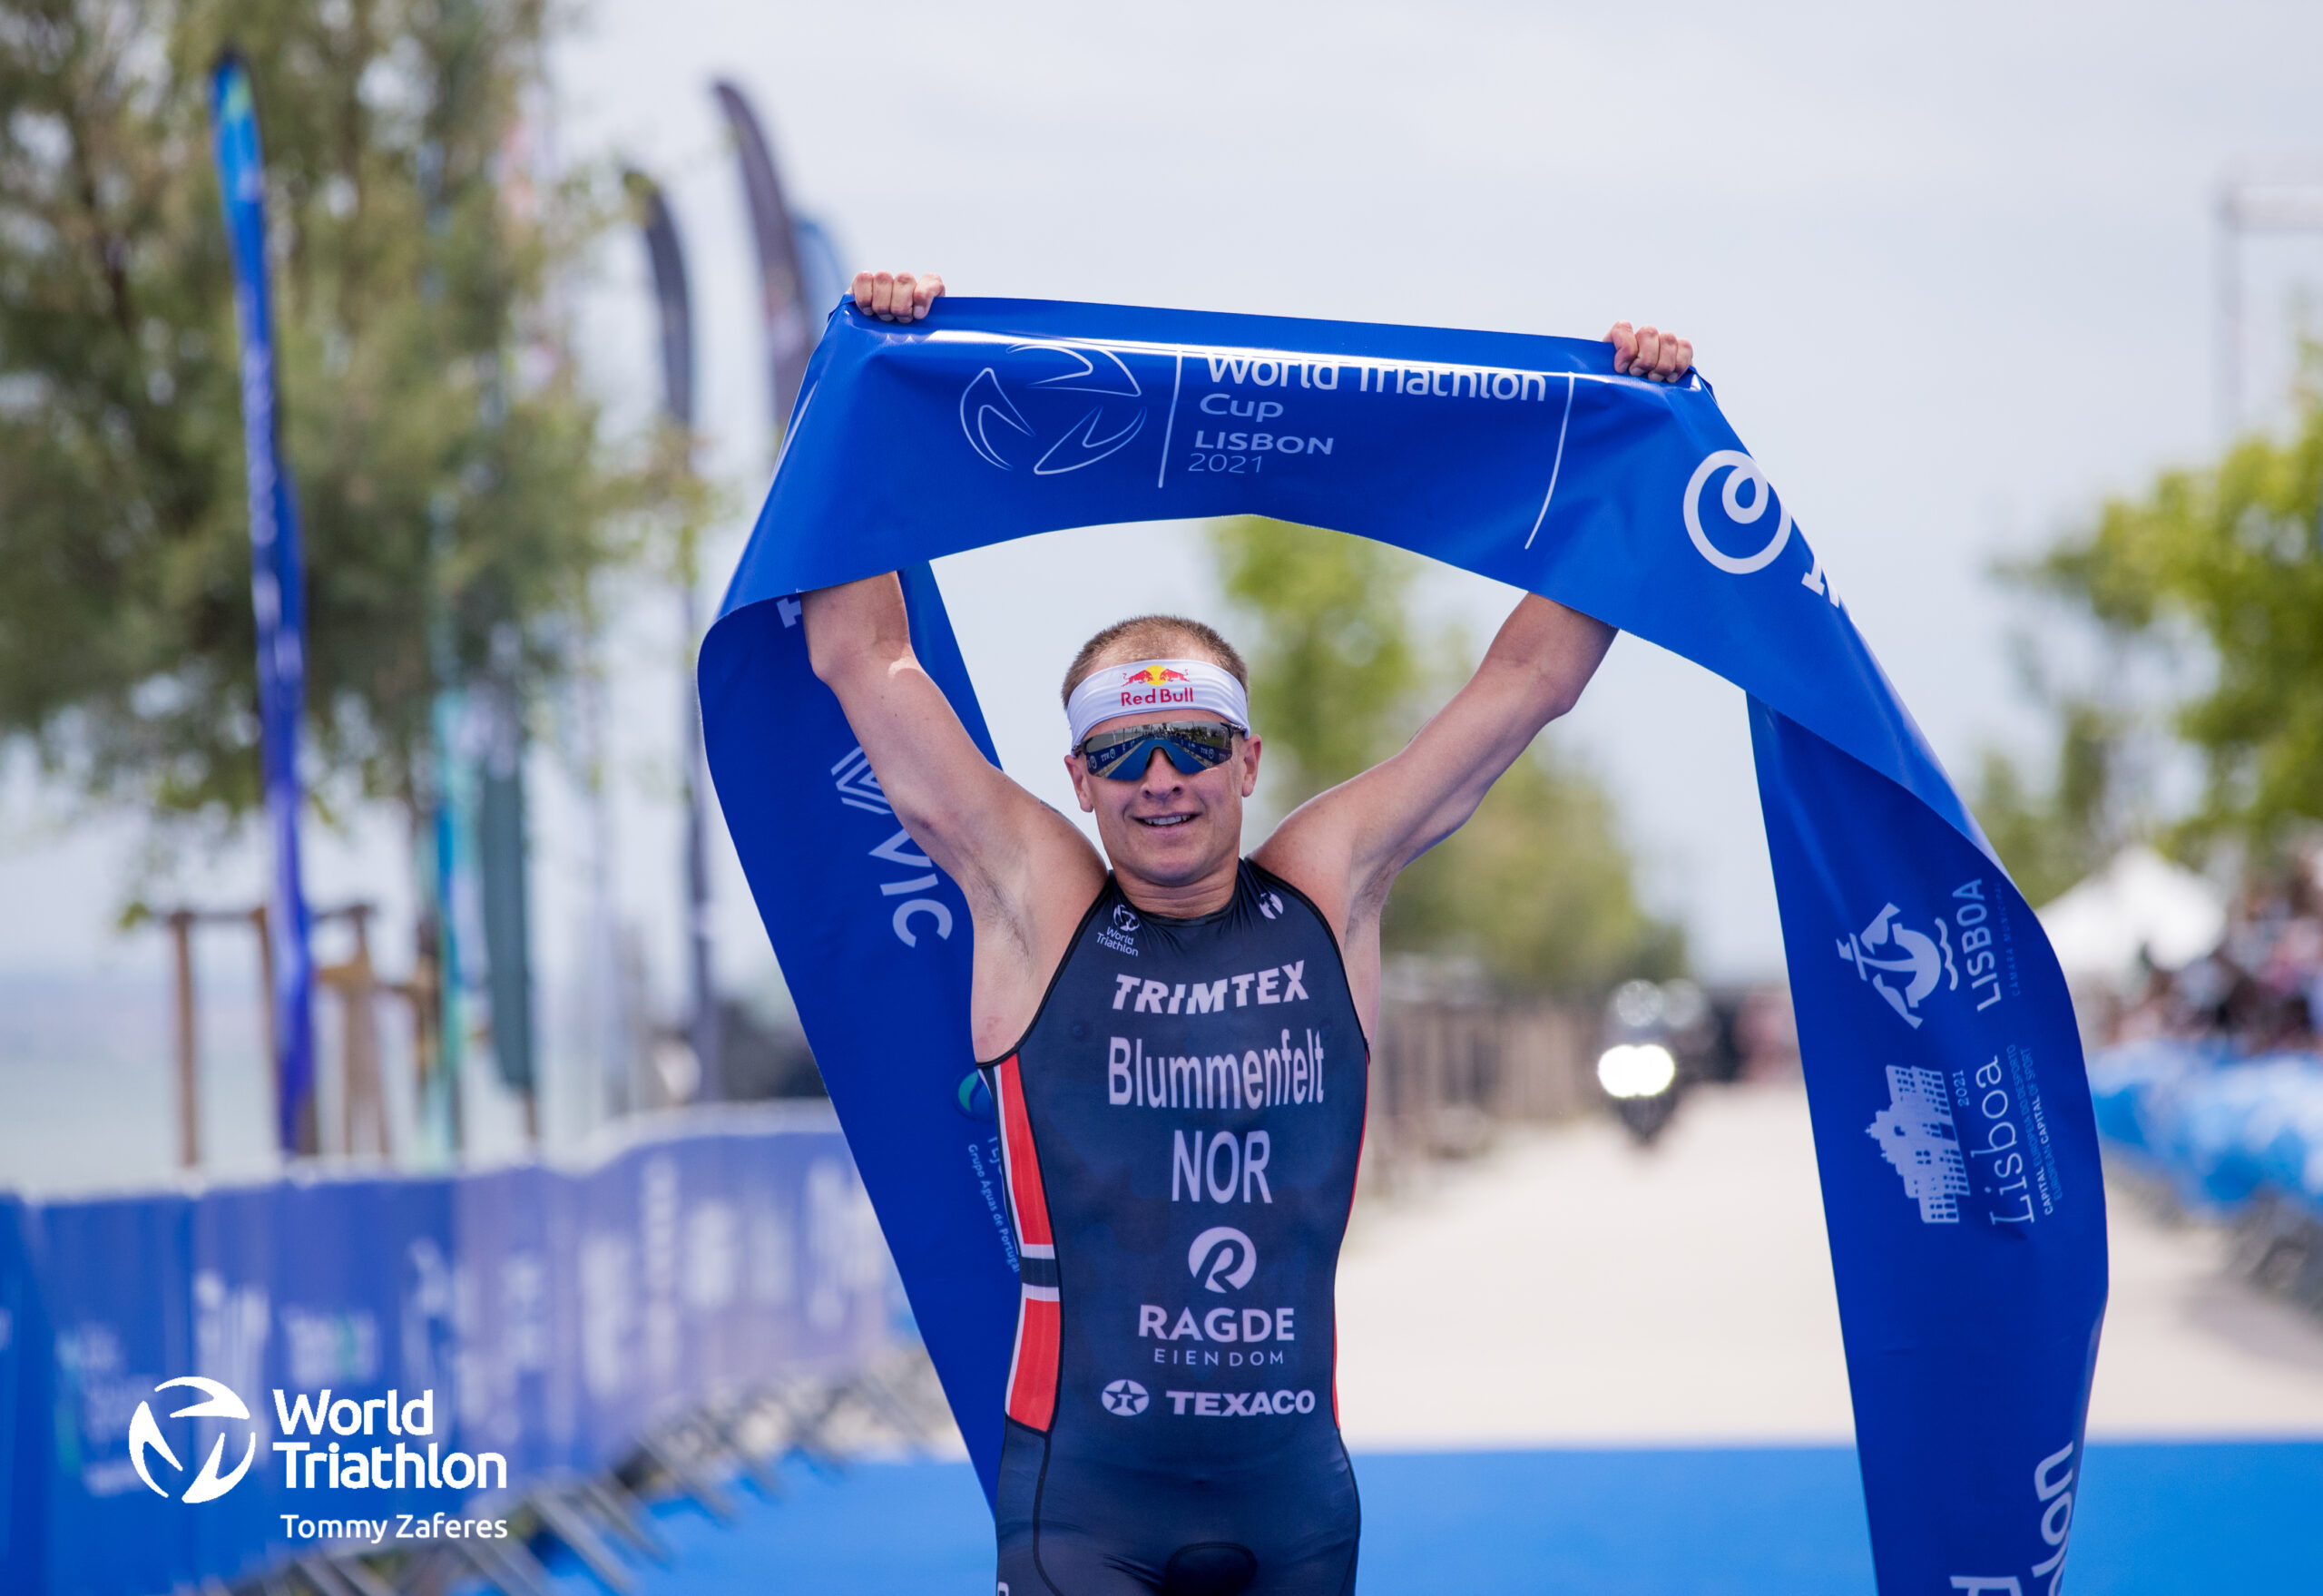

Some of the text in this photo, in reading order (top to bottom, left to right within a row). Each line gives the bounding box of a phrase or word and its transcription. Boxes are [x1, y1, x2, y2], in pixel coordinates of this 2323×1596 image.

[1206, 351, 1339, 391] World
[1200, 393, 1284, 423] Cup
[1194, 430, 1334, 455] LISBON
[1188, 453, 1263, 474] 2021
[1121, 687, 1194, 707] Red Bull
[1096, 932, 1139, 957] Triathlon
[1106, 925, 1134, 945] World
[1952, 877, 2002, 1013] LISBOA
[1112, 959, 1309, 1015] TRIMTEX
[1107, 1028, 1325, 1111] Blummenfelt
[1952, 1069, 1970, 1108] 2021
[2031, 1093, 2050, 1145] CAPITAL
[1970, 1054, 2034, 1226] Lisboa
[967, 1143, 985, 1178] Grupo
[980, 1180, 998, 1212] Águas
[993, 1213, 1004, 1228] de
[1171, 1129, 1273, 1204] NOR
[2035, 1166, 2053, 1216] CAPITAL
[1138, 1304, 1295, 1343] RAGDE
[1153, 1347, 1284, 1367] EIENDOM
[1165, 1389, 1316, 1417] TEXACO
